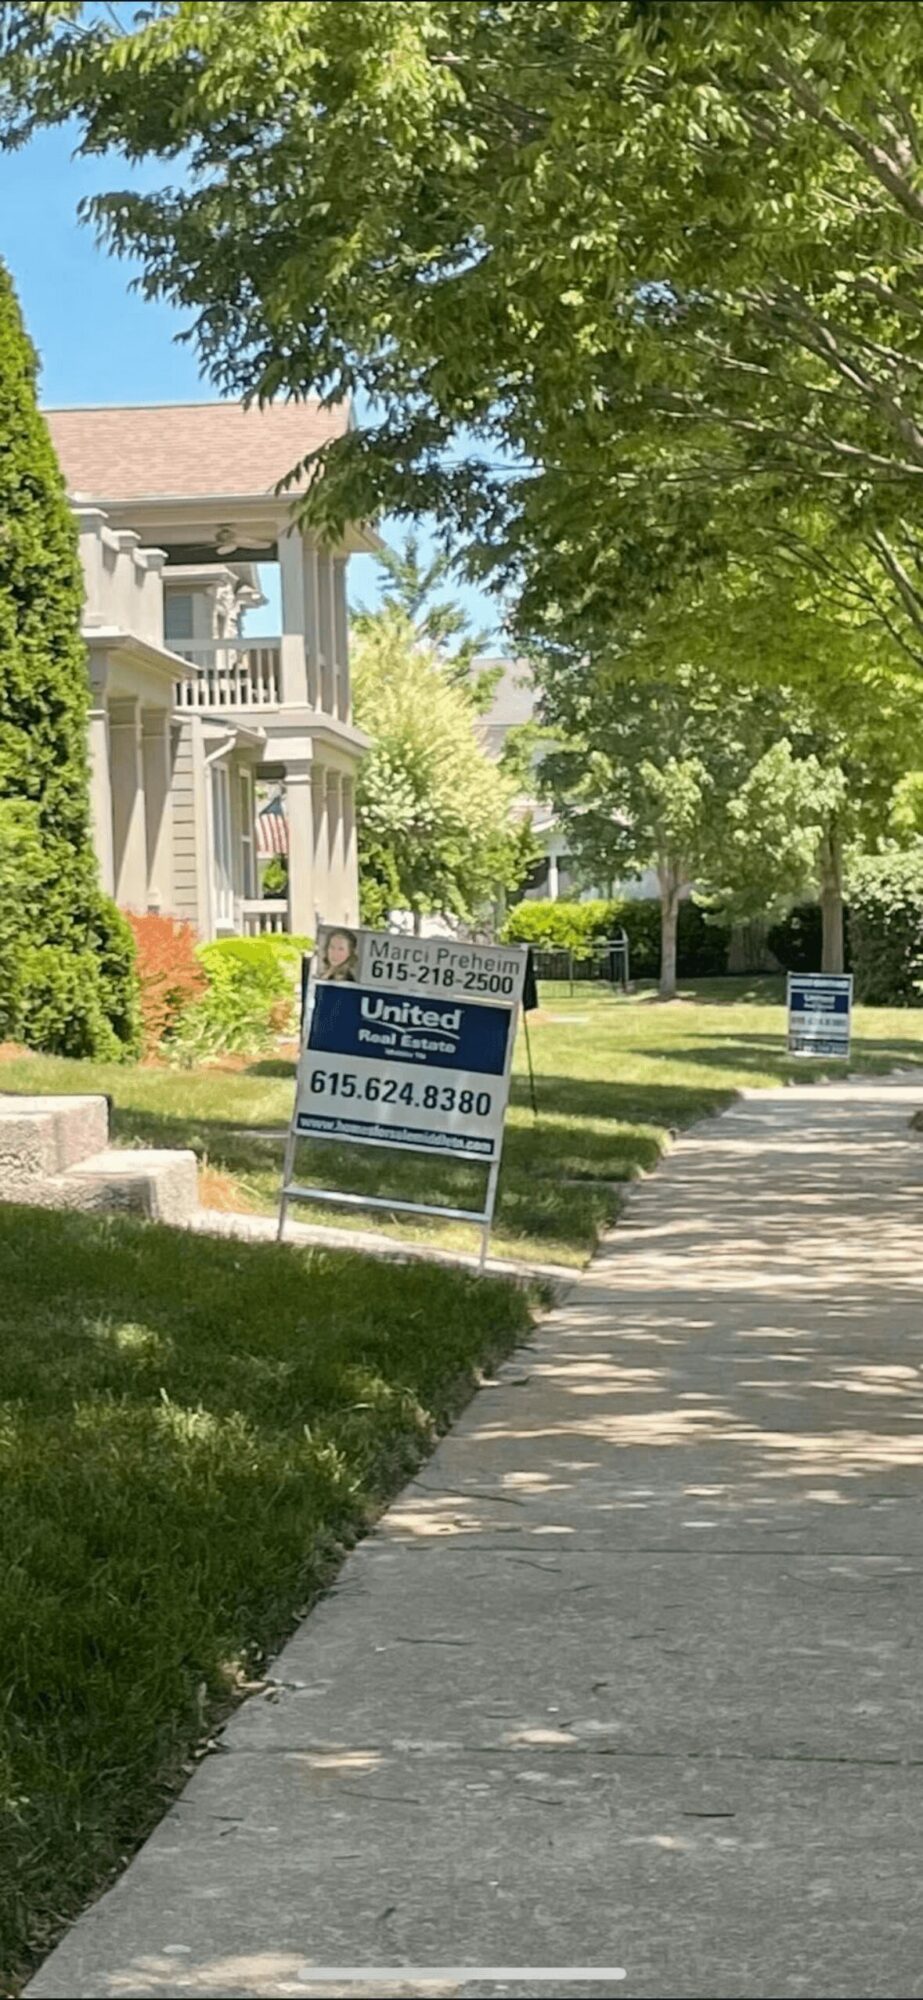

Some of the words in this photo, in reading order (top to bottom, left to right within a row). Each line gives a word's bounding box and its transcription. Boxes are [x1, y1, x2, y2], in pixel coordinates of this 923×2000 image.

[370, 939, 429, 964] Marci
[437, 947, 520, 975] Preheim
[371, 960, 514, 994] 615-218-2500
[361, 996, 461, 1030] United
[358, 1029, 397, 1046] Real
[401, 1035, 457, 1054] Estate
[310, 1070, 492, 1116] 615.624.8380
